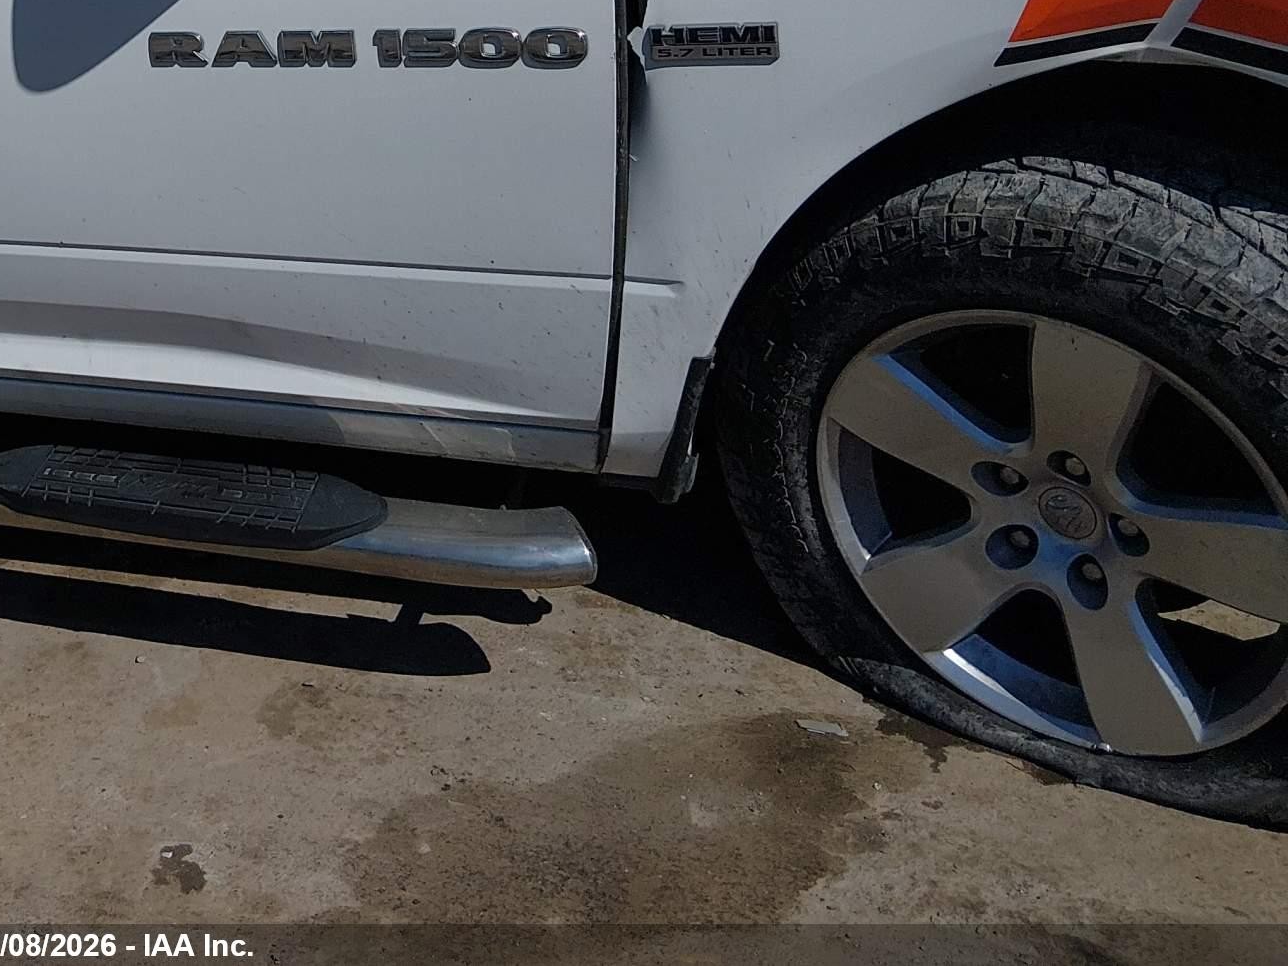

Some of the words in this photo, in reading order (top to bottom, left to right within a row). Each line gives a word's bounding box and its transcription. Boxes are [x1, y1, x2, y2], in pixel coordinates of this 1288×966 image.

[651, 25, 776, 45] HEMI
[148, 30, 357, 68] RAM
[373, 28, 588, 69] 1500
[657, 48, 694, 59] 5.7
[702, 46, 773, 58] LITER
